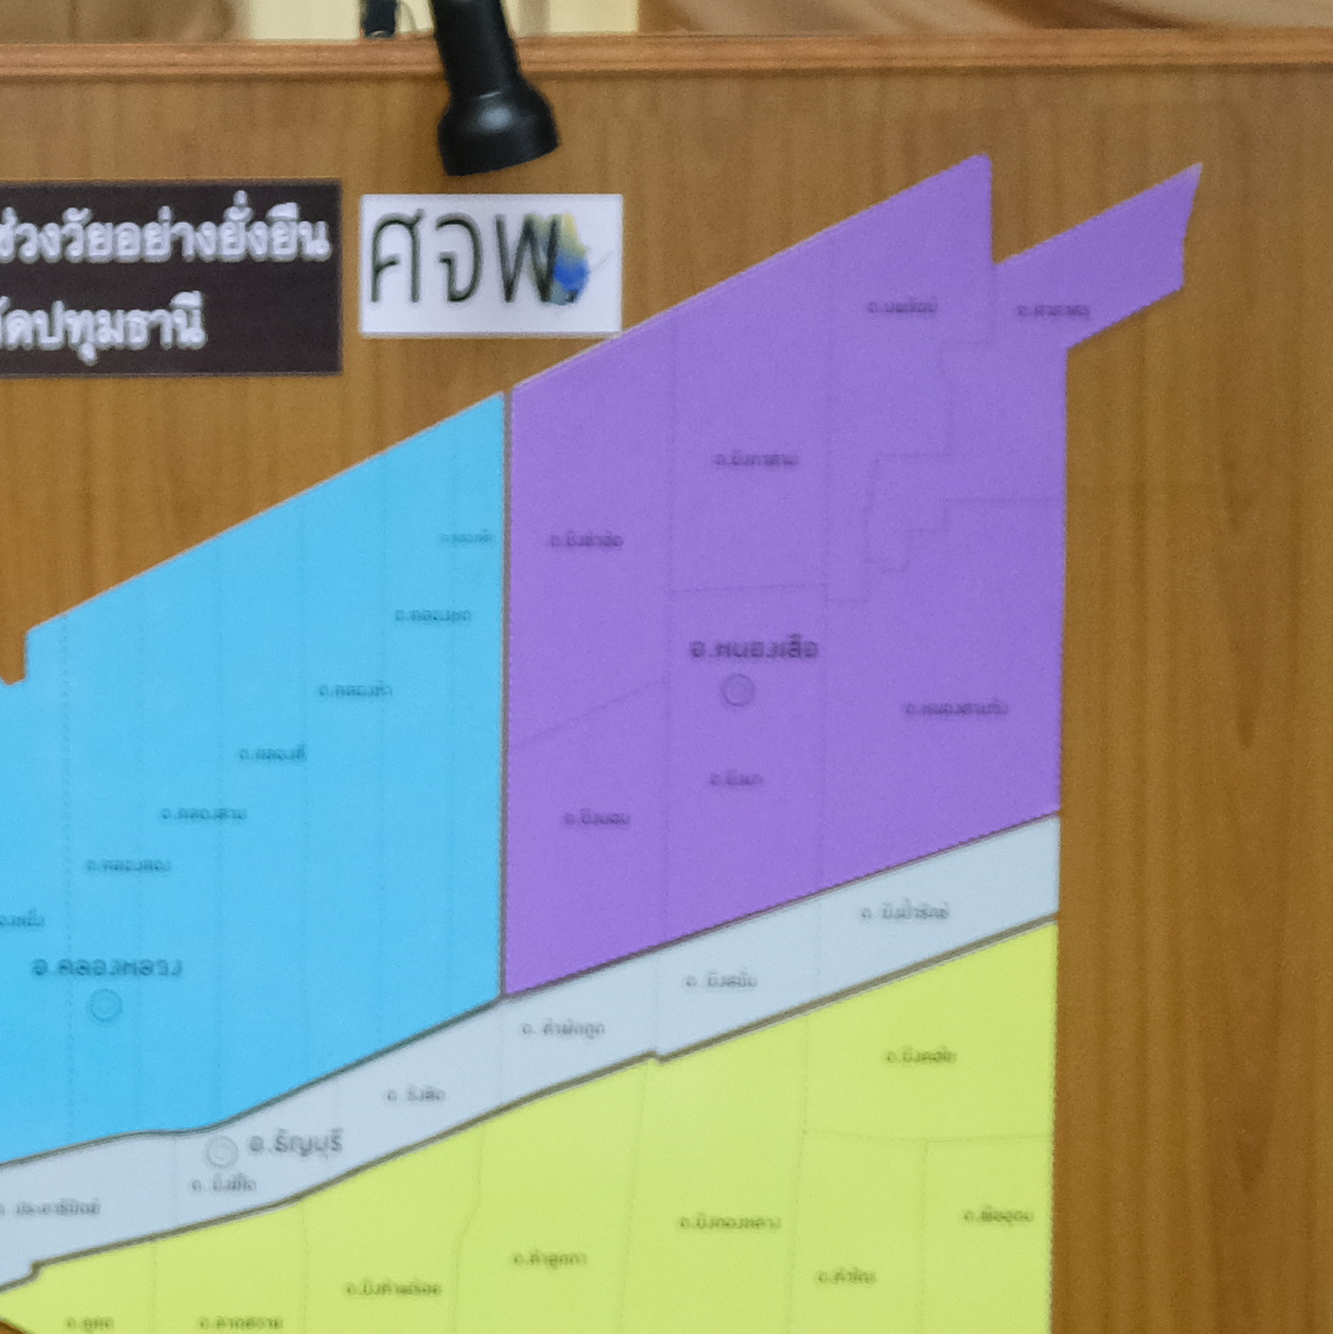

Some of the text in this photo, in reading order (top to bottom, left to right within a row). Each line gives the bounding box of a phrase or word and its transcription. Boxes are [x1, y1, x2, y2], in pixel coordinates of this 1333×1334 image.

[370, 209, 561, 303] ศจพ
[689, 633, 819, 660] อ.หนองเสือ
